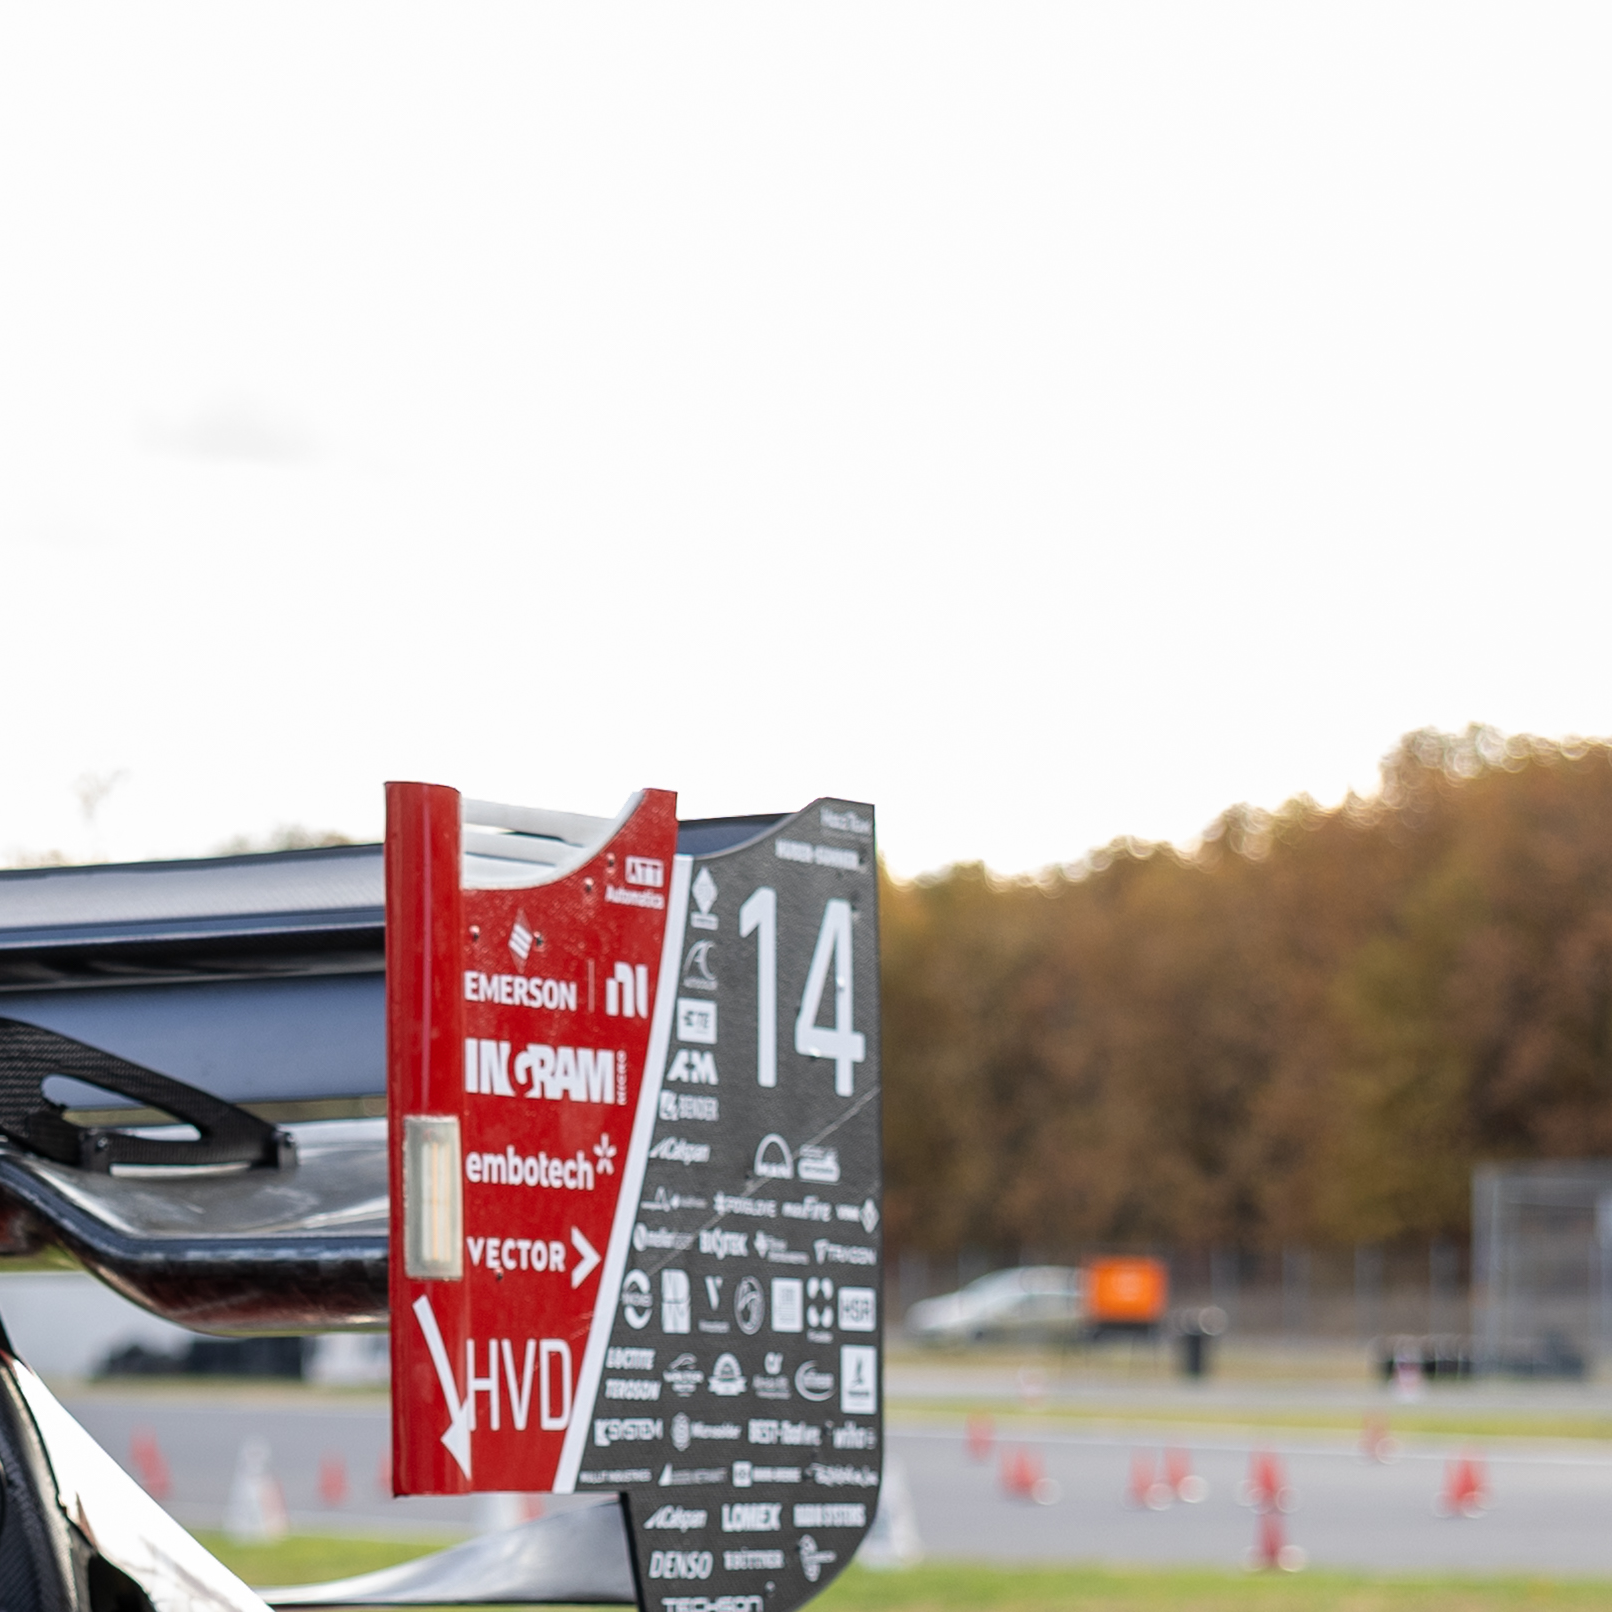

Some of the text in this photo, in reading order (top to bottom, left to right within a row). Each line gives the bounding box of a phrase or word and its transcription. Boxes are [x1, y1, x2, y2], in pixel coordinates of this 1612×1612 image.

[464, 971, 577, 1011] EMERSON
[739, 886, 865, 1098] 14
[465, 1037, 615, 1104] INGRAM
[465, 1146, 594, 1190] embotech
[466, 1236, 566, 1272] VECTOR
[466, 1339, 572, 1431] HVD
[649, 1551, 714, 1580] DENSO
